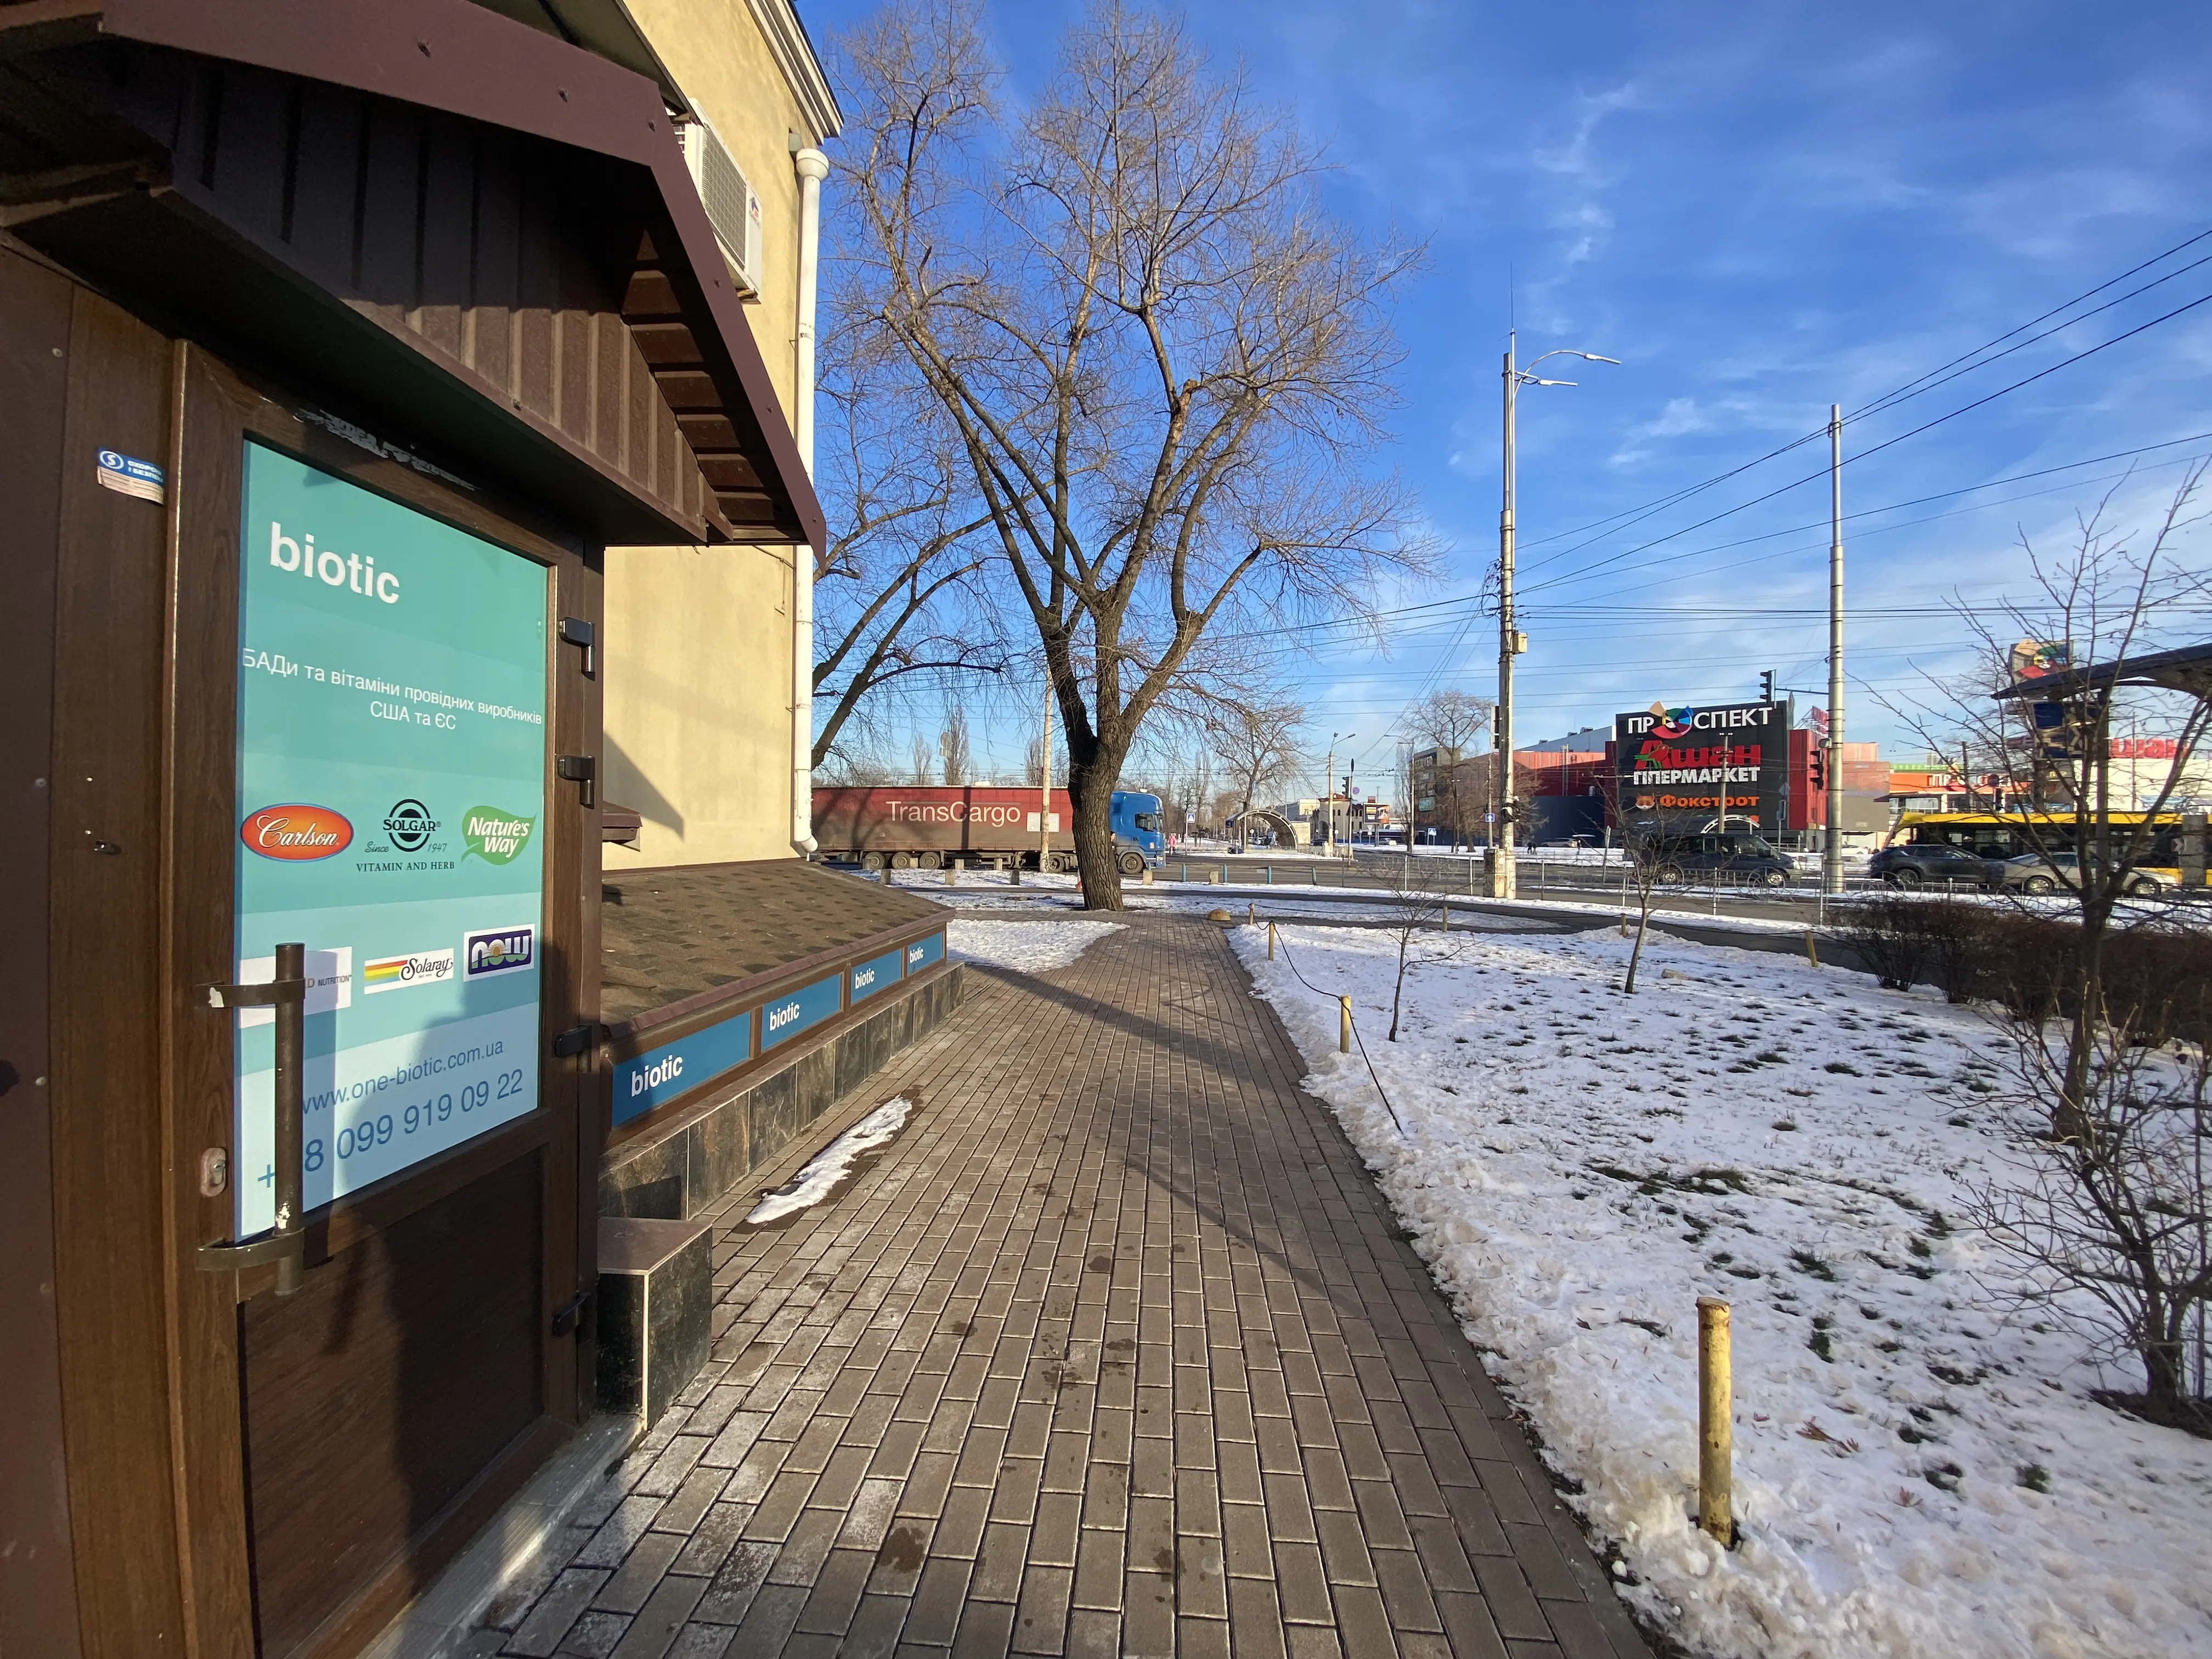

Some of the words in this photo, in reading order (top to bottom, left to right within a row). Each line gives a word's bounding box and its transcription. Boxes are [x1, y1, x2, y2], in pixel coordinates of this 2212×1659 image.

[270, 521, 399, 604] biotic
[243, 648, 298, 678] БАДи
[303, 665, 325, 682] та
[331, 669, 399, 696] вітаміни
[405, 686, 475, 712] провідних
[478, 702, 542, 725] виробників
[370, 701, 410, 722] США
[415, 712, 431, 725] та
[435, 713, 456, 730] ЄС
[1633, 766, 1760, 785] ГІПЕРМАРКЕТ
[885, 800, 1020, 828] TransCargo
[257, 815, 338, 848] Carlson
[467, 816, 530, 837] Nature's
[365, 841, 389, 853] Since
[427, 843, 447, 853] 1947
[484, 837, 520, 858] Way
[356, 862, 403, 872] VITAMIN
[407, 862, 427, 870] AND
[431, 861, 454, 870] HERB
[910, 946, 924, 963] biotic
[401, 958, 453, 980] Solaray
[855, 968, 874, 989] biotic
[318, 975, 349, 986] NUTRITION
[769, 1001, 800, 1031] biotic
[631, 1054, 682, 1097] biotic
[337, 1114, 393, 1159] 099
[404, 1093, 452, 1134] 919
[461, 1080, 489, 1112] 09
[496, 1069, 523, 1099] 22
